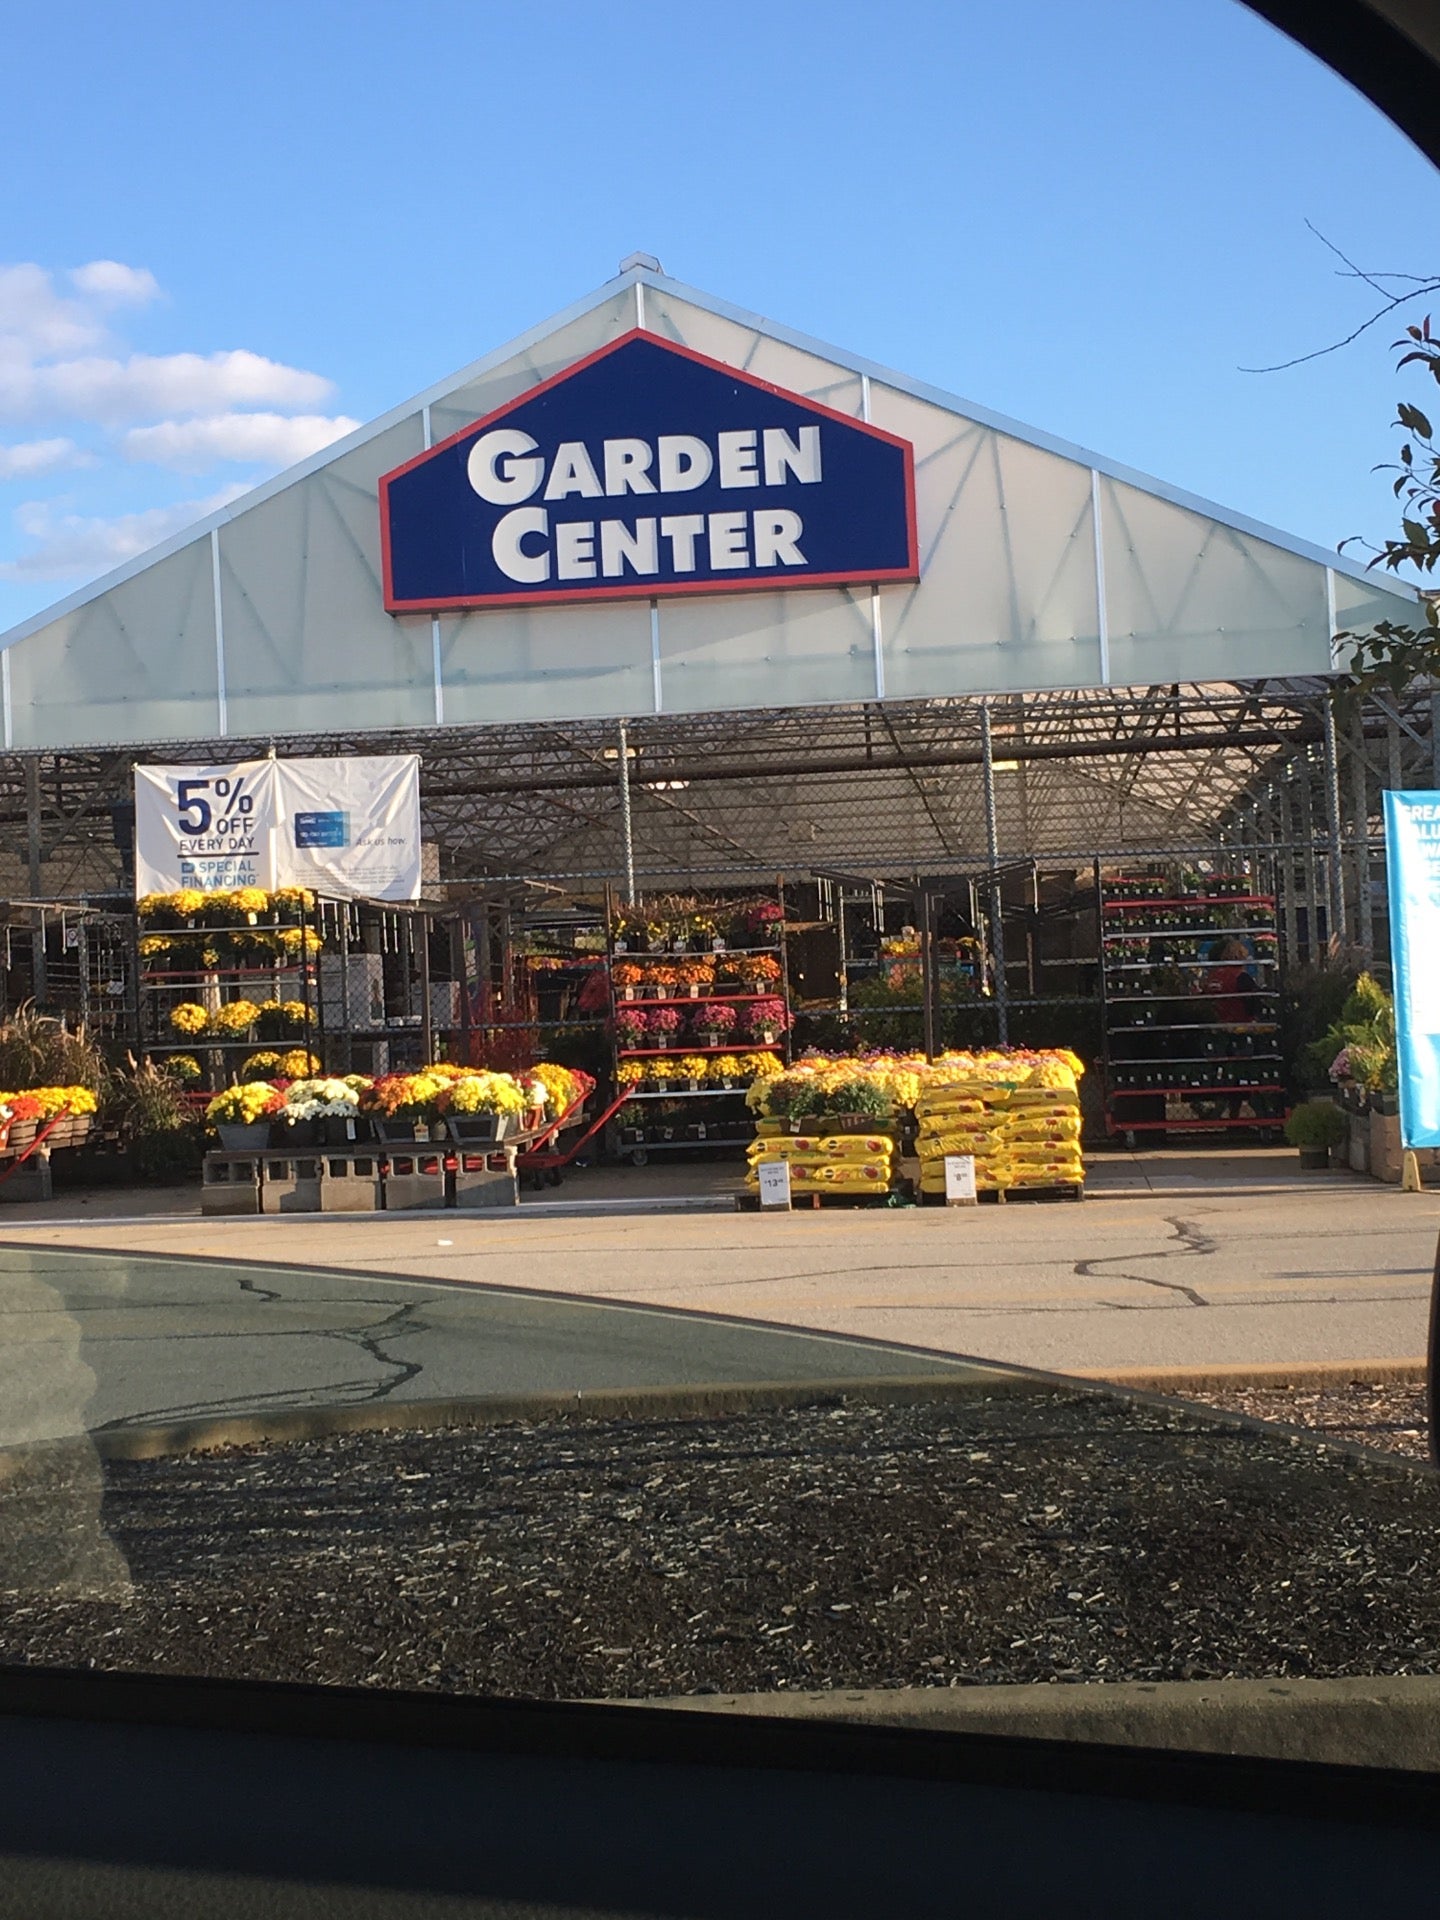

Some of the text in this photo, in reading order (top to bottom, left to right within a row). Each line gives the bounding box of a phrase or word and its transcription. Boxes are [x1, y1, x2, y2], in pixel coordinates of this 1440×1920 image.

[467, 425, 823, 506] GARDEN
[492, 506, 809, 583] CENTER
[178, 778, 253, 835] 5%
[217, 817, 254, 835] OFF
[180, 837, 255, 851] EVERY DAY
[199, 860, 255, 873] SPECIAL
[181, 874, 256, 888] FINANCING
